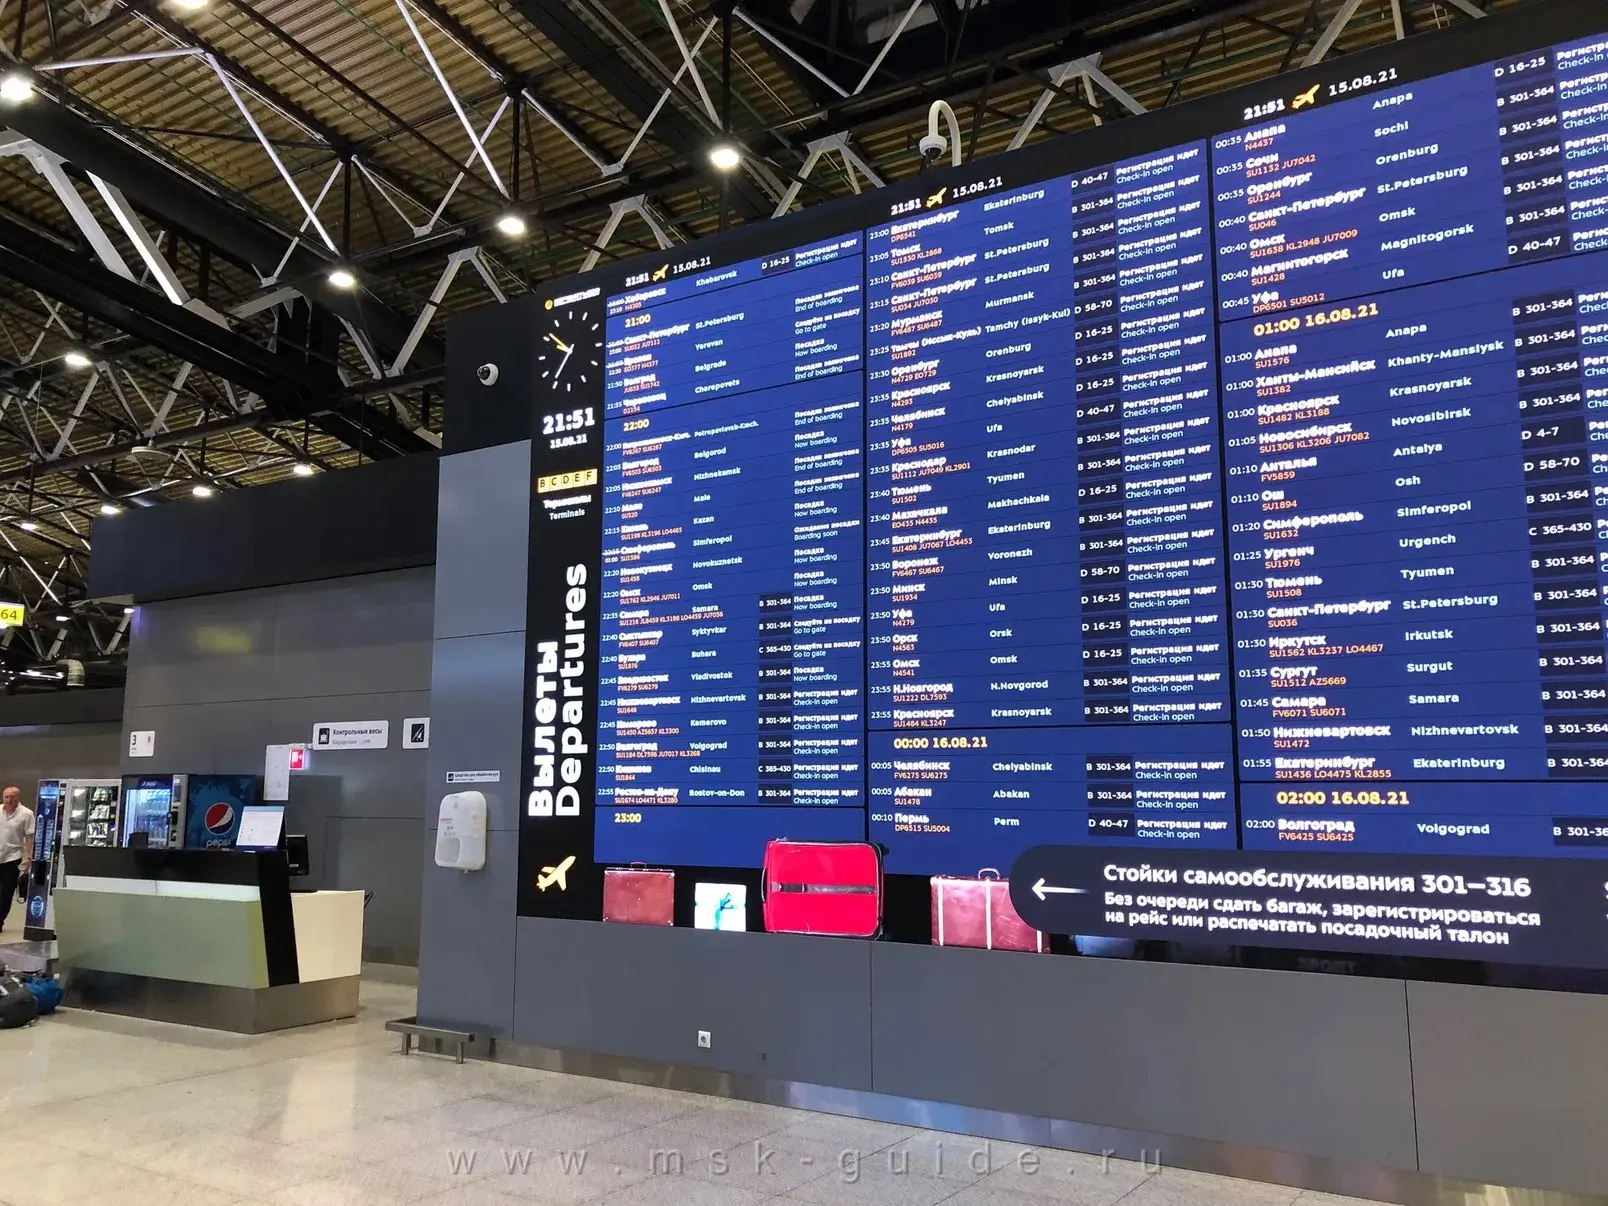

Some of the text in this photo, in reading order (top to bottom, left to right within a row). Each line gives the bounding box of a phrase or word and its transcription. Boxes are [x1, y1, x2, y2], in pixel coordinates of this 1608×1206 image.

[1494, 56, 1546, 77] D 16-25
[1243, 67, 1397, 120] 21:51 15.08.21
[1372, 92, 1413, 110] Anapa
[1243, 123, 1286, 143] Анапа
[1374, 120, 1408, 137] Sochi
[1215, 135, 1242, 149] 00:35
[1245, 152, 1279, 169] Сочи
[1375, 143, 1438, 165] Orenburg
[1246, 171, 1313, 196] Оренбург
[1377, 165, 1468, 194] St.Petersburg
[891, 176, 1002, 215] 21:51 15.08.21
[983, 189, 1044, 211] Ekaterinburg
[1247, 186, 1366, 222] Санкт-Петербург
[1378, 206, 1416, 222] Omsk
[983, 221, 1014, 235] Tomsk
[1218, 215, 1246, 228] 00:40
[1248, 233, 1286, 250] Омск
[1380, 223, 1474, 251] Magnitogorsk
[984, 238, 1049, 259] St.Petersburg
[1507, 235, 1561, 255] D 40-47
[1250, 248, 1349, 277] Магнитогорск
[625, 256, 711, 287] 21:51 15.08.21
[695, 269, 737, 287] Khabarovsk
[984, 263, 1049, 284] St.Petersburg
[1382, 268, 1404, 279] Ufa
[984, 290, 1034, 309] Murmansk
[1222, 296, 1249, 309] 00:45
[1250, 290, 1279, 304] Уфа
[624, 313, 651, 328] 21:00
[695, 312, 744, 329] St.Petersburg
[1253, 302, 1378, 336] 01:00 16.08.21
[1385, 324, 1427, 338] Anapa
[694, 339, 723, 350] Yerevan
[985, 342, 1031, 358] Orenburg
[1224, 351, 1253, 364] 01:00
[1253, 344, 1297, 360] Анапа
[1387, 340, 1504, 367] Khanty-Mansiysk
[694, 359, 726, 372] Belgrade
[985, 365, 1044, 383] Krasnoyarsk
[1255, 359, 1376, 388] Ханты-Мансийск
[694, 379, 740, 394] Cherepovets
[1389, 376, 1472, 397] Krasnoyarsk
[985, 390, 1044, 408] Chelyabinsk
[1257, 394, 1340, 416] Красноярск
[543, 407, 595, 435] 21:51
[1391, 407, 1471, 427] Novosibirsk
[623, 418, 650, 432] 22:00
[986, 423, 1003, 433] Ufa
[1258, 422, 1353, 444] Новосибирск
[1521, 426, 1559, 440] D 4-7
[1228, 435, 1256, 447] 01:05
[693, 446, 726, 459] Belgorod
[986, 444, 1036, 458] Krasnodar
[1392, 443, 1442, 457] Antalya
[1259, 456, 1317, 473] Анталья
[540, 471, 592, 488] B C D E F
[986, 472, 1025, 485] Tyumen
[1395, 475, 1421, 487] Osh
[987, 494, 1050, 509] Makhachkala
[1230, 492, 1259, 504] 01:10
[1261, 489, 1284, 501] Ош
[549, 508, 585, 520] Terminals
[1396, 500, 1471, 517] Simferopol
[693, 516, 714, 525] Kazan
[1262, 511, 1364, 530] Симферополь
[1528, 522, 1592, 536] C 365-430
[1399, 533, 1456, 549] Urgench
[987, 547, 1033, 560] Voronezh
[1233, 550, 1261, 561] 01:25
[1263, 545, 1314, 560] Ургенч
[1400, 566, 1454, 580] Tyumen
[988, 575, 1017, 586] Minsk
[1264, 575, 1323, 589] Тюмень
[1533, 588, 1597, 601] B 301-364
[989, 602, 1005, 612] Ufa
[1266, 599, 1392, 618] Санкт-Петербург
[1402, 595, 1498, 610] St.Petersburg
[1268, 618, 1298, 628] SU036
[989, 628, 1012, 638] Orsk
[1404, 628, 1453, 641] Irkutsk
[1268, 635, 1327, 648] Иркутск
[990, 654, 1017, 664] Omsk
[1238, 668, 1267, 678] 01:35
[1269, 665, 1318, 678] Сургут
[1406, 661, 1453, 674] Surgut
[690, 671, 733, 680] Vladivostok
[555, 563, 588, 817] Departures
[990, 679, 1048, 691] N.Novgorod
[1271, 696, 1326, 708] Самара
[1408, 694, 1459, 704] Samara
[528, 640, 559, 817] Вылеты
[1272, 725, 1391, 738] Нижневартовск
[1411, 723, 1519, 736] Nizhnevartovsk
[893, 736, 988, 749] 00:00 16.08.21
[1273, 739, 1310, 748] SU1472
[689, 765, 721, 773] Chisinau
[992, 761, 1053, 773] Chelyabinsk
[1242, 758, 1272, 767] 01:55
[1274, 755, 1376, 769] Екатеринбург
[1413, 757, 1505, 770] Ekaterinburg
[688, 789, 745, 797] Rostov-on-Don
[992, 789, 1030, 798] Abakan
[1276, 791, 1409, 805] 02:00 16.08.21
[614, 812, 642, 823] 23:00
[993, 817, 1020, 826] Perm
[1245, 819, 1275, 828] 02:00
[1277, 818, 1356, 832] Волгоград
[1416, 822, 1490, 836] Volgograd
[1137, 829, 1200, 840] Check-in open
[1278, 831, 1354, 841] FV6425 SU6425
[206, 839, 231, 848] pepsi
[1103, 863, 1178, 884] Стойки
[1183, 868, 1415, 893] самообслуживания
[1104, 891, 1541, 926] Без очереди сдать багаж, зарегистрироваться
[1105, 910, 1510, 945] на рейс или распечатать посадочный талон
